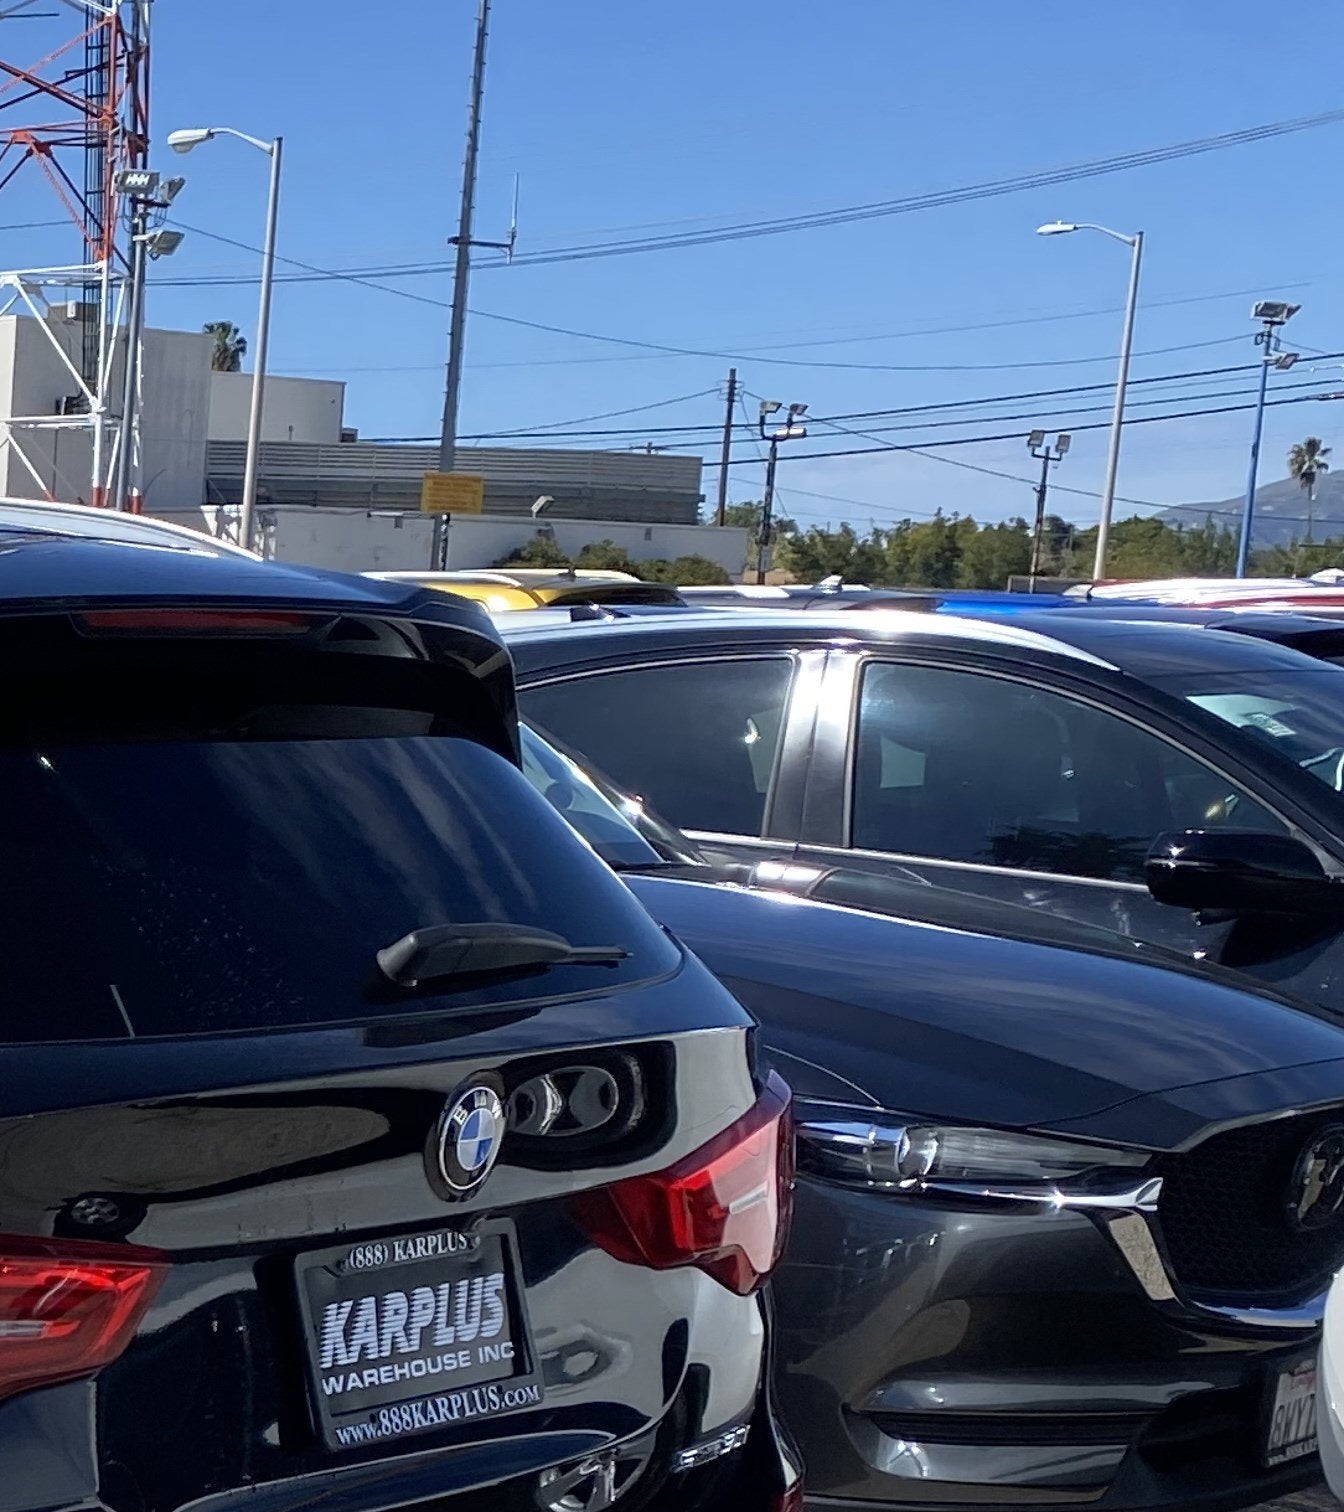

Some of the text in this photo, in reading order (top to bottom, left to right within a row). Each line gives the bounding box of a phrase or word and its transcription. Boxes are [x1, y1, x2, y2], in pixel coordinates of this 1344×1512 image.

[349, 1231, 468, 1269] (888) KARPLUS
[319, 1273, 505, 1369] KARPLUS
[321, 1341, 515, 1396] WAREHOUSE INC
